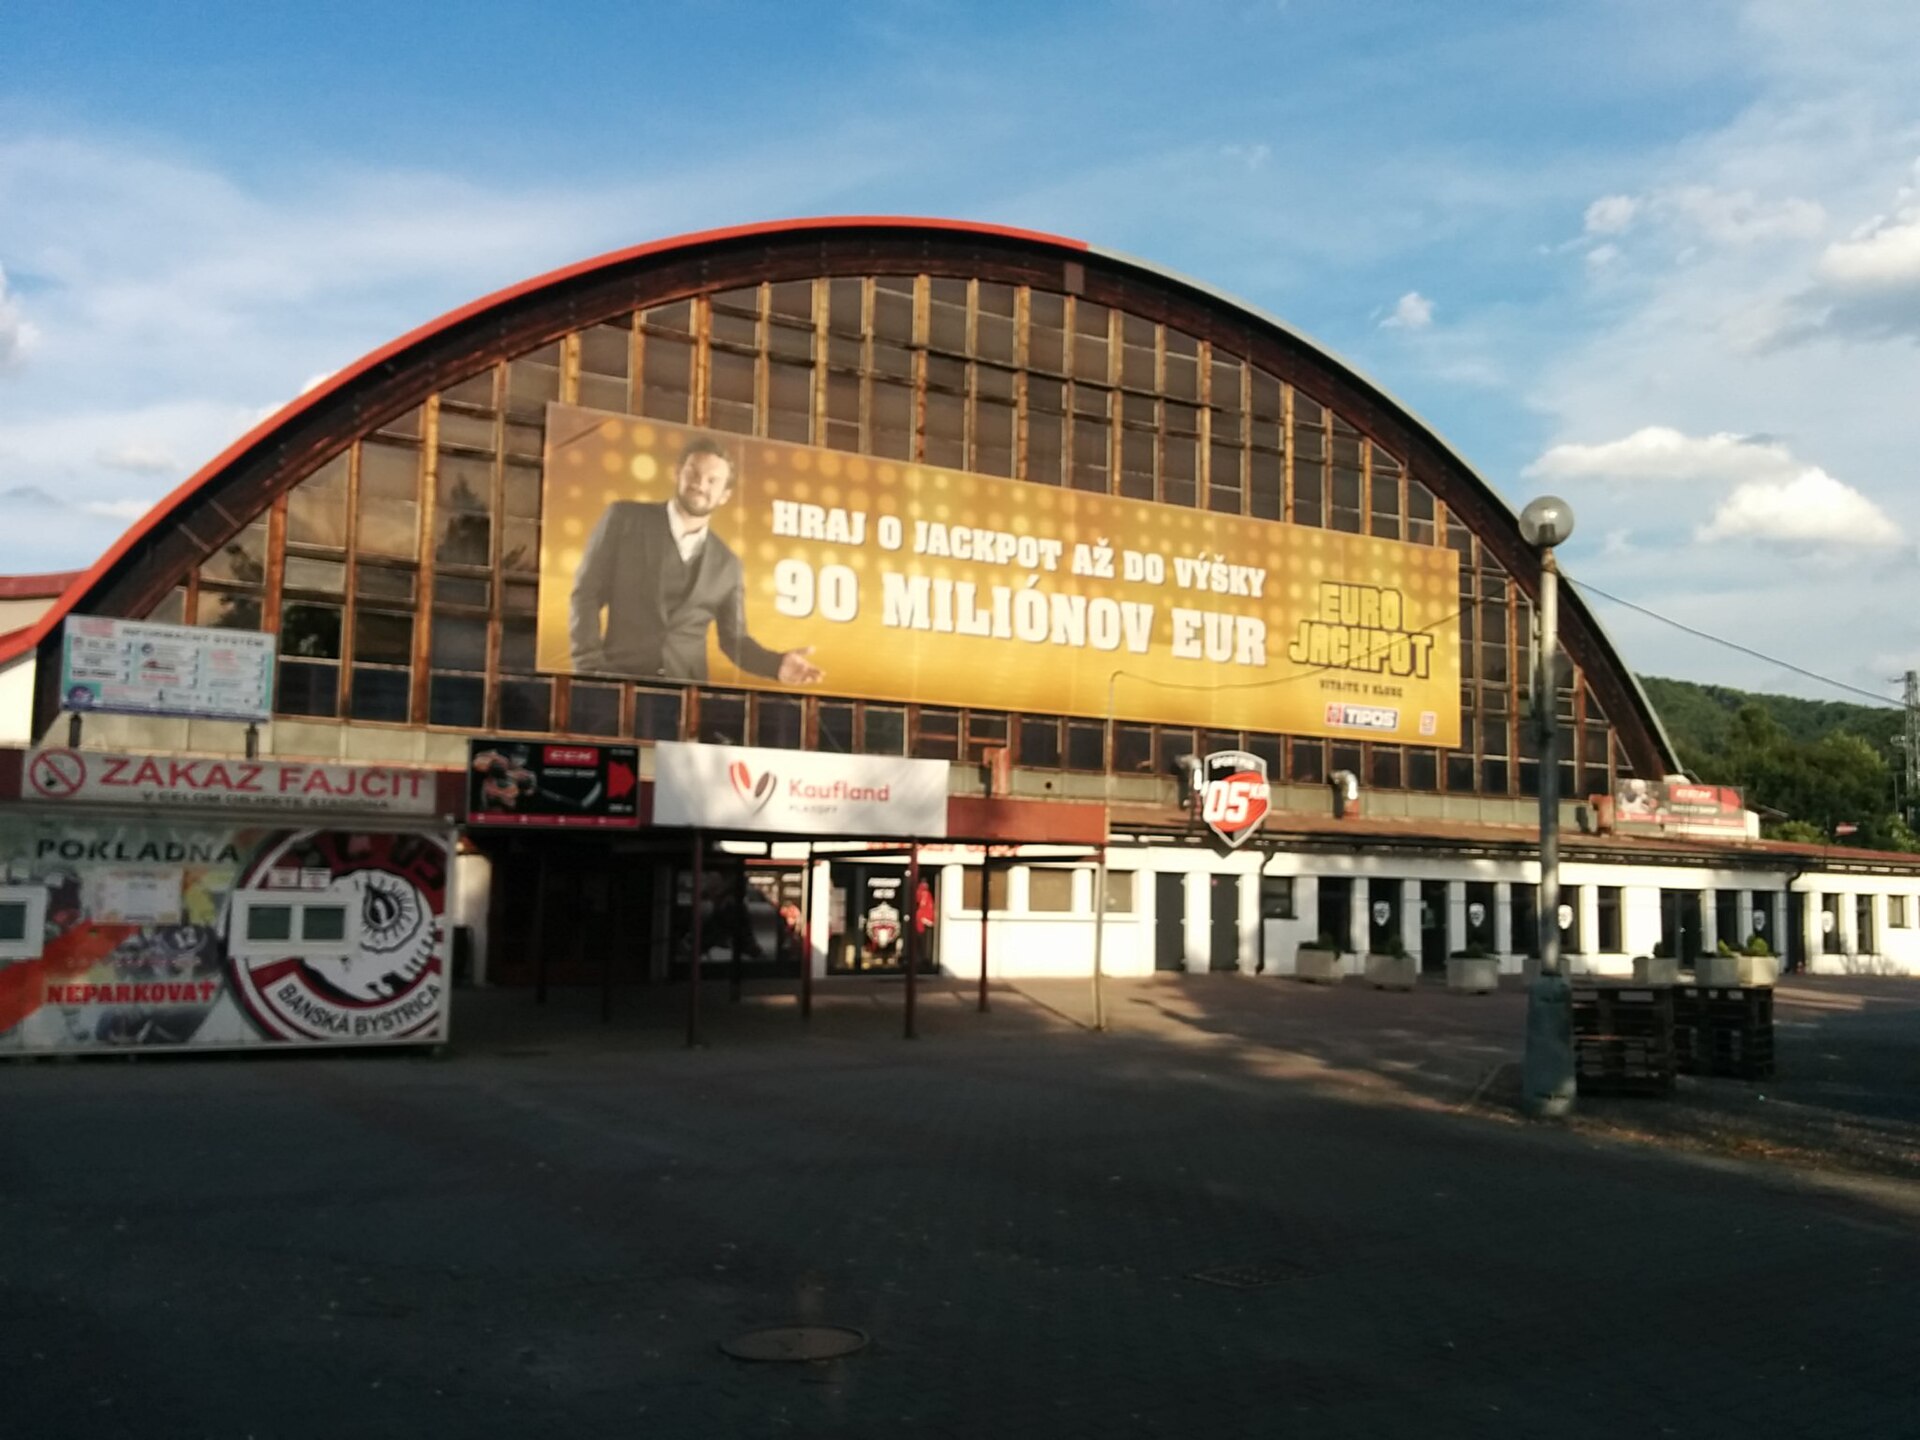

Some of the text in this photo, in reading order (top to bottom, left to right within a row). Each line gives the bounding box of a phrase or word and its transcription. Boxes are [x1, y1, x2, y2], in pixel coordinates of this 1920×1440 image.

[772, 500, 1267, 598] HRAJ O JACKPOT AŽ DO VÝŠKY
[773, 558, 1267, 667] 90 MILIÓNOV EUR
[1319, 581, 1403, 631] EURO
[1288, 620, 1434, 679] JACKPOT
[1345, 707, 1396, 728] TIPOS
[789, 779, 890, 801] Kaufland
[36, 838, 240, 863] POKLADNA
[354, 984, 441, 1036] BYSTRICA
